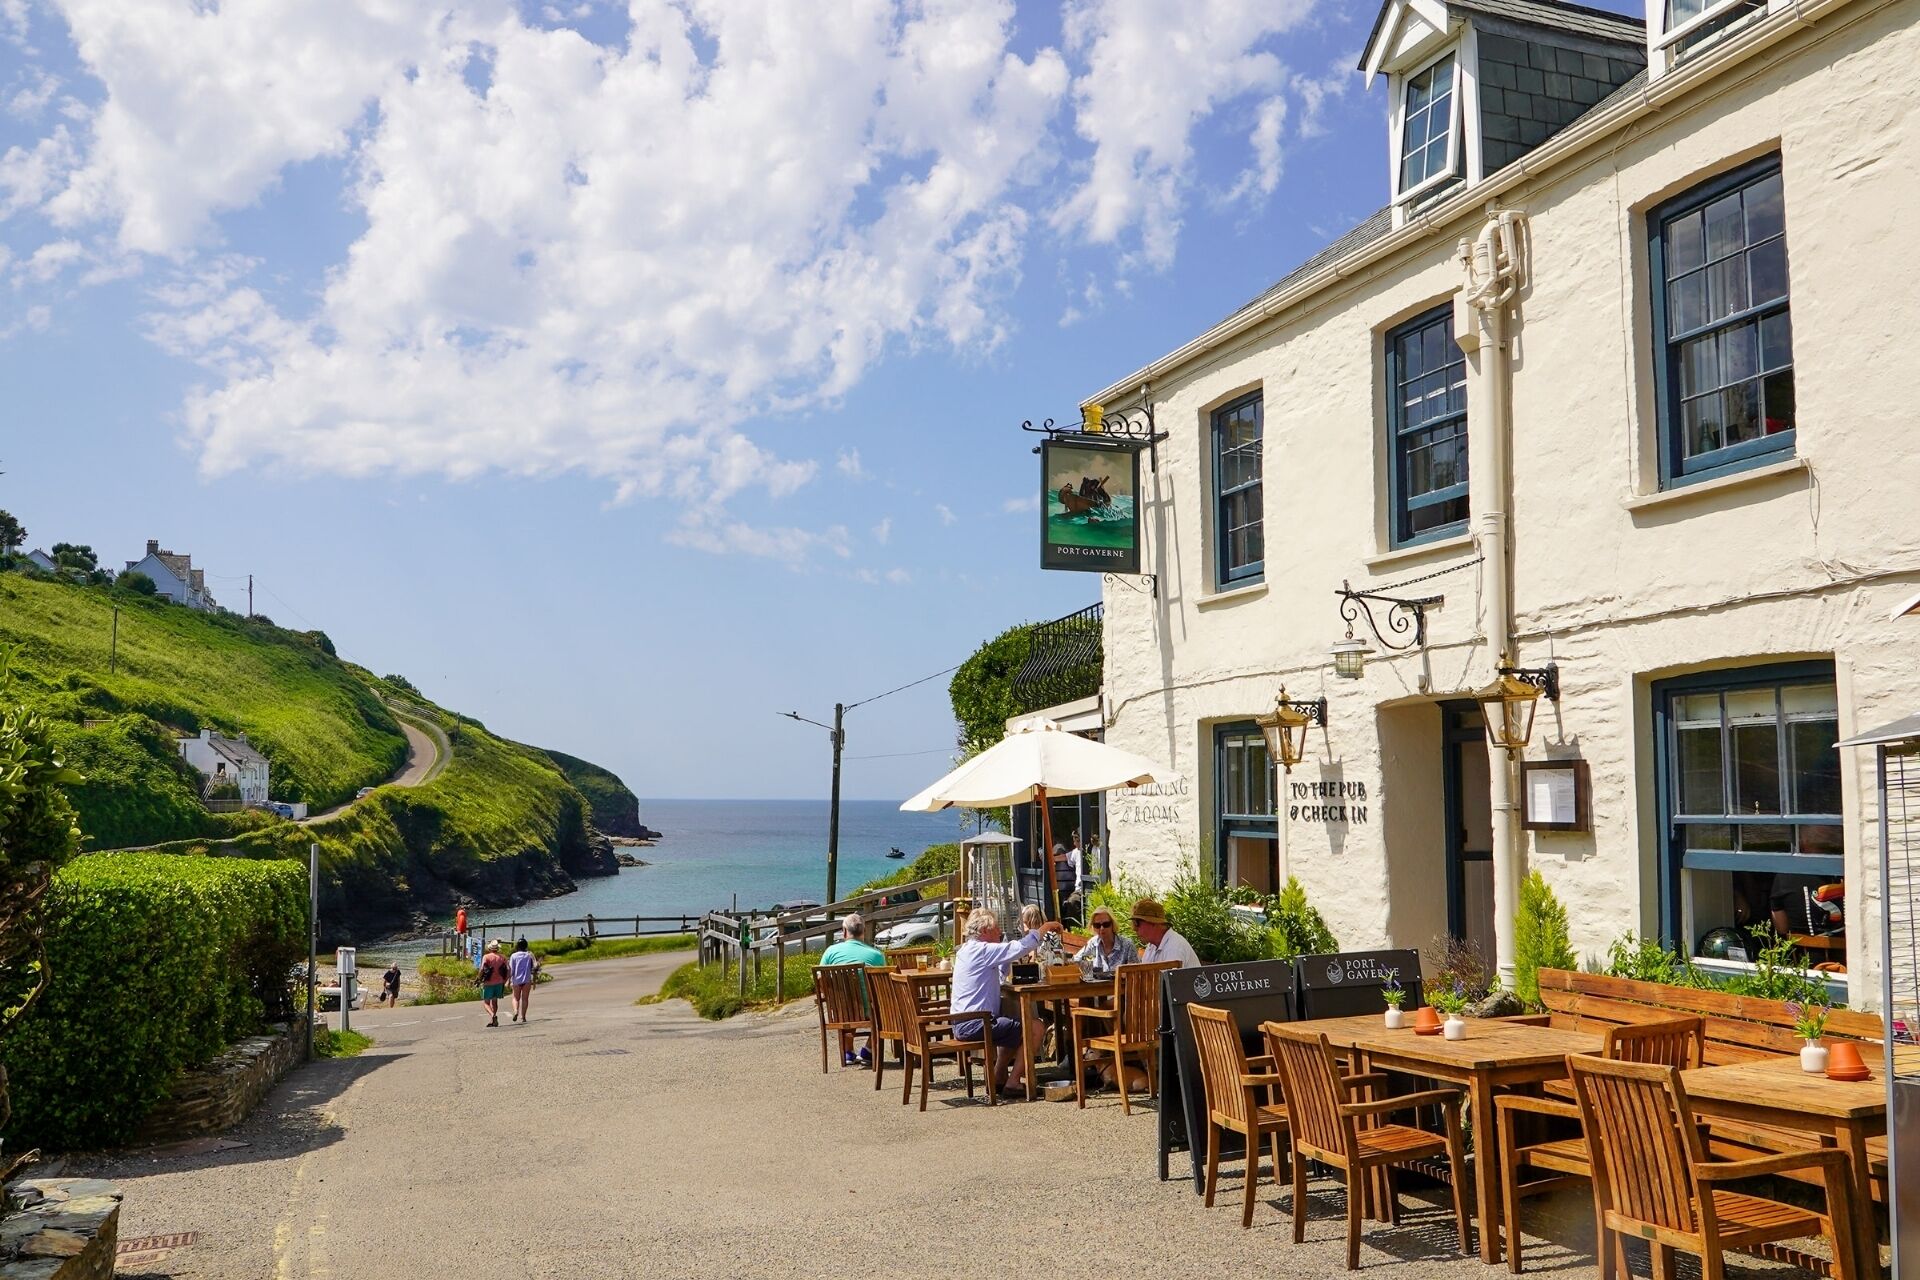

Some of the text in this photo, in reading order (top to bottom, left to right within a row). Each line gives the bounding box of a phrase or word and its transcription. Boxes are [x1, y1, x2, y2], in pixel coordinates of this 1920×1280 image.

[1057, 546, 1124, 558] PORT GAVERNE
[1290, 781, 1367, 800] TO THE PUB
[1290, 805, 1368, 823] & CHECK IN
[1345, 958, 1375, 970] PORT
[1214, 970, 1244, 983] PORT
[1215, 978, 1270, 993] GAVERNE
